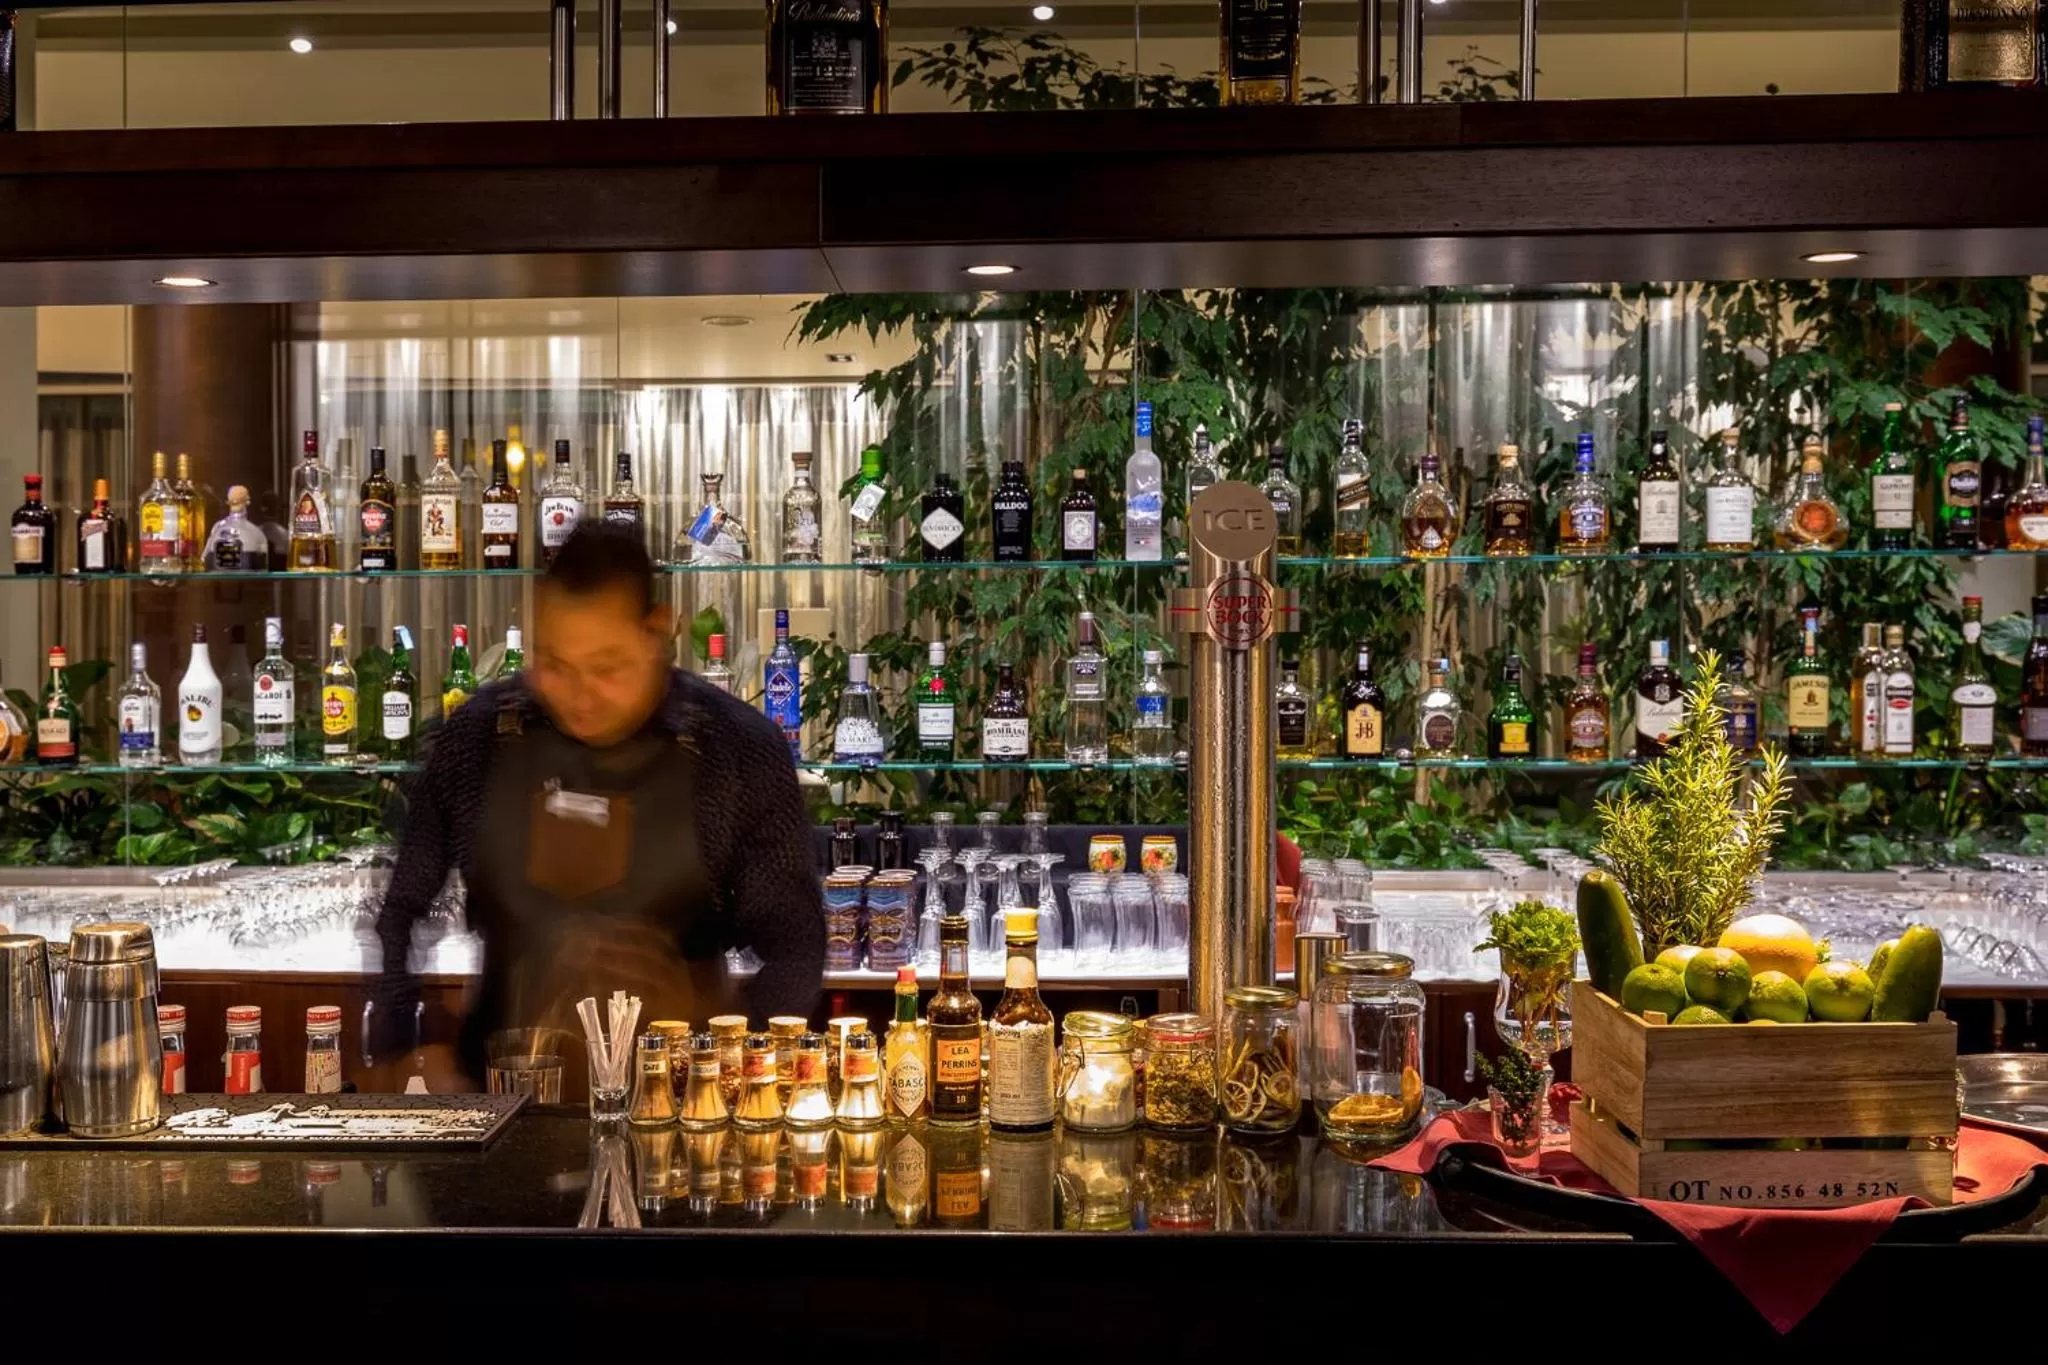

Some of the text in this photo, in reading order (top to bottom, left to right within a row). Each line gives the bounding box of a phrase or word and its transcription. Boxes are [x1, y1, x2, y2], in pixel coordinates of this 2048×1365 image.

[995, 502, 1028, 510] BULLDOG
[1203, 509, 1265, 531] ICE
[1213, 596, 1267, 610] SUPER
[1215, 610, 1264, 625] BOCK
[951, 1046, 970, 1056] LEA
[941, 1060, 978, 1070] PERRINS
[1818, 1182, 1844, 1198] 48
[1856, 1181, 1899, 1197] 52N
